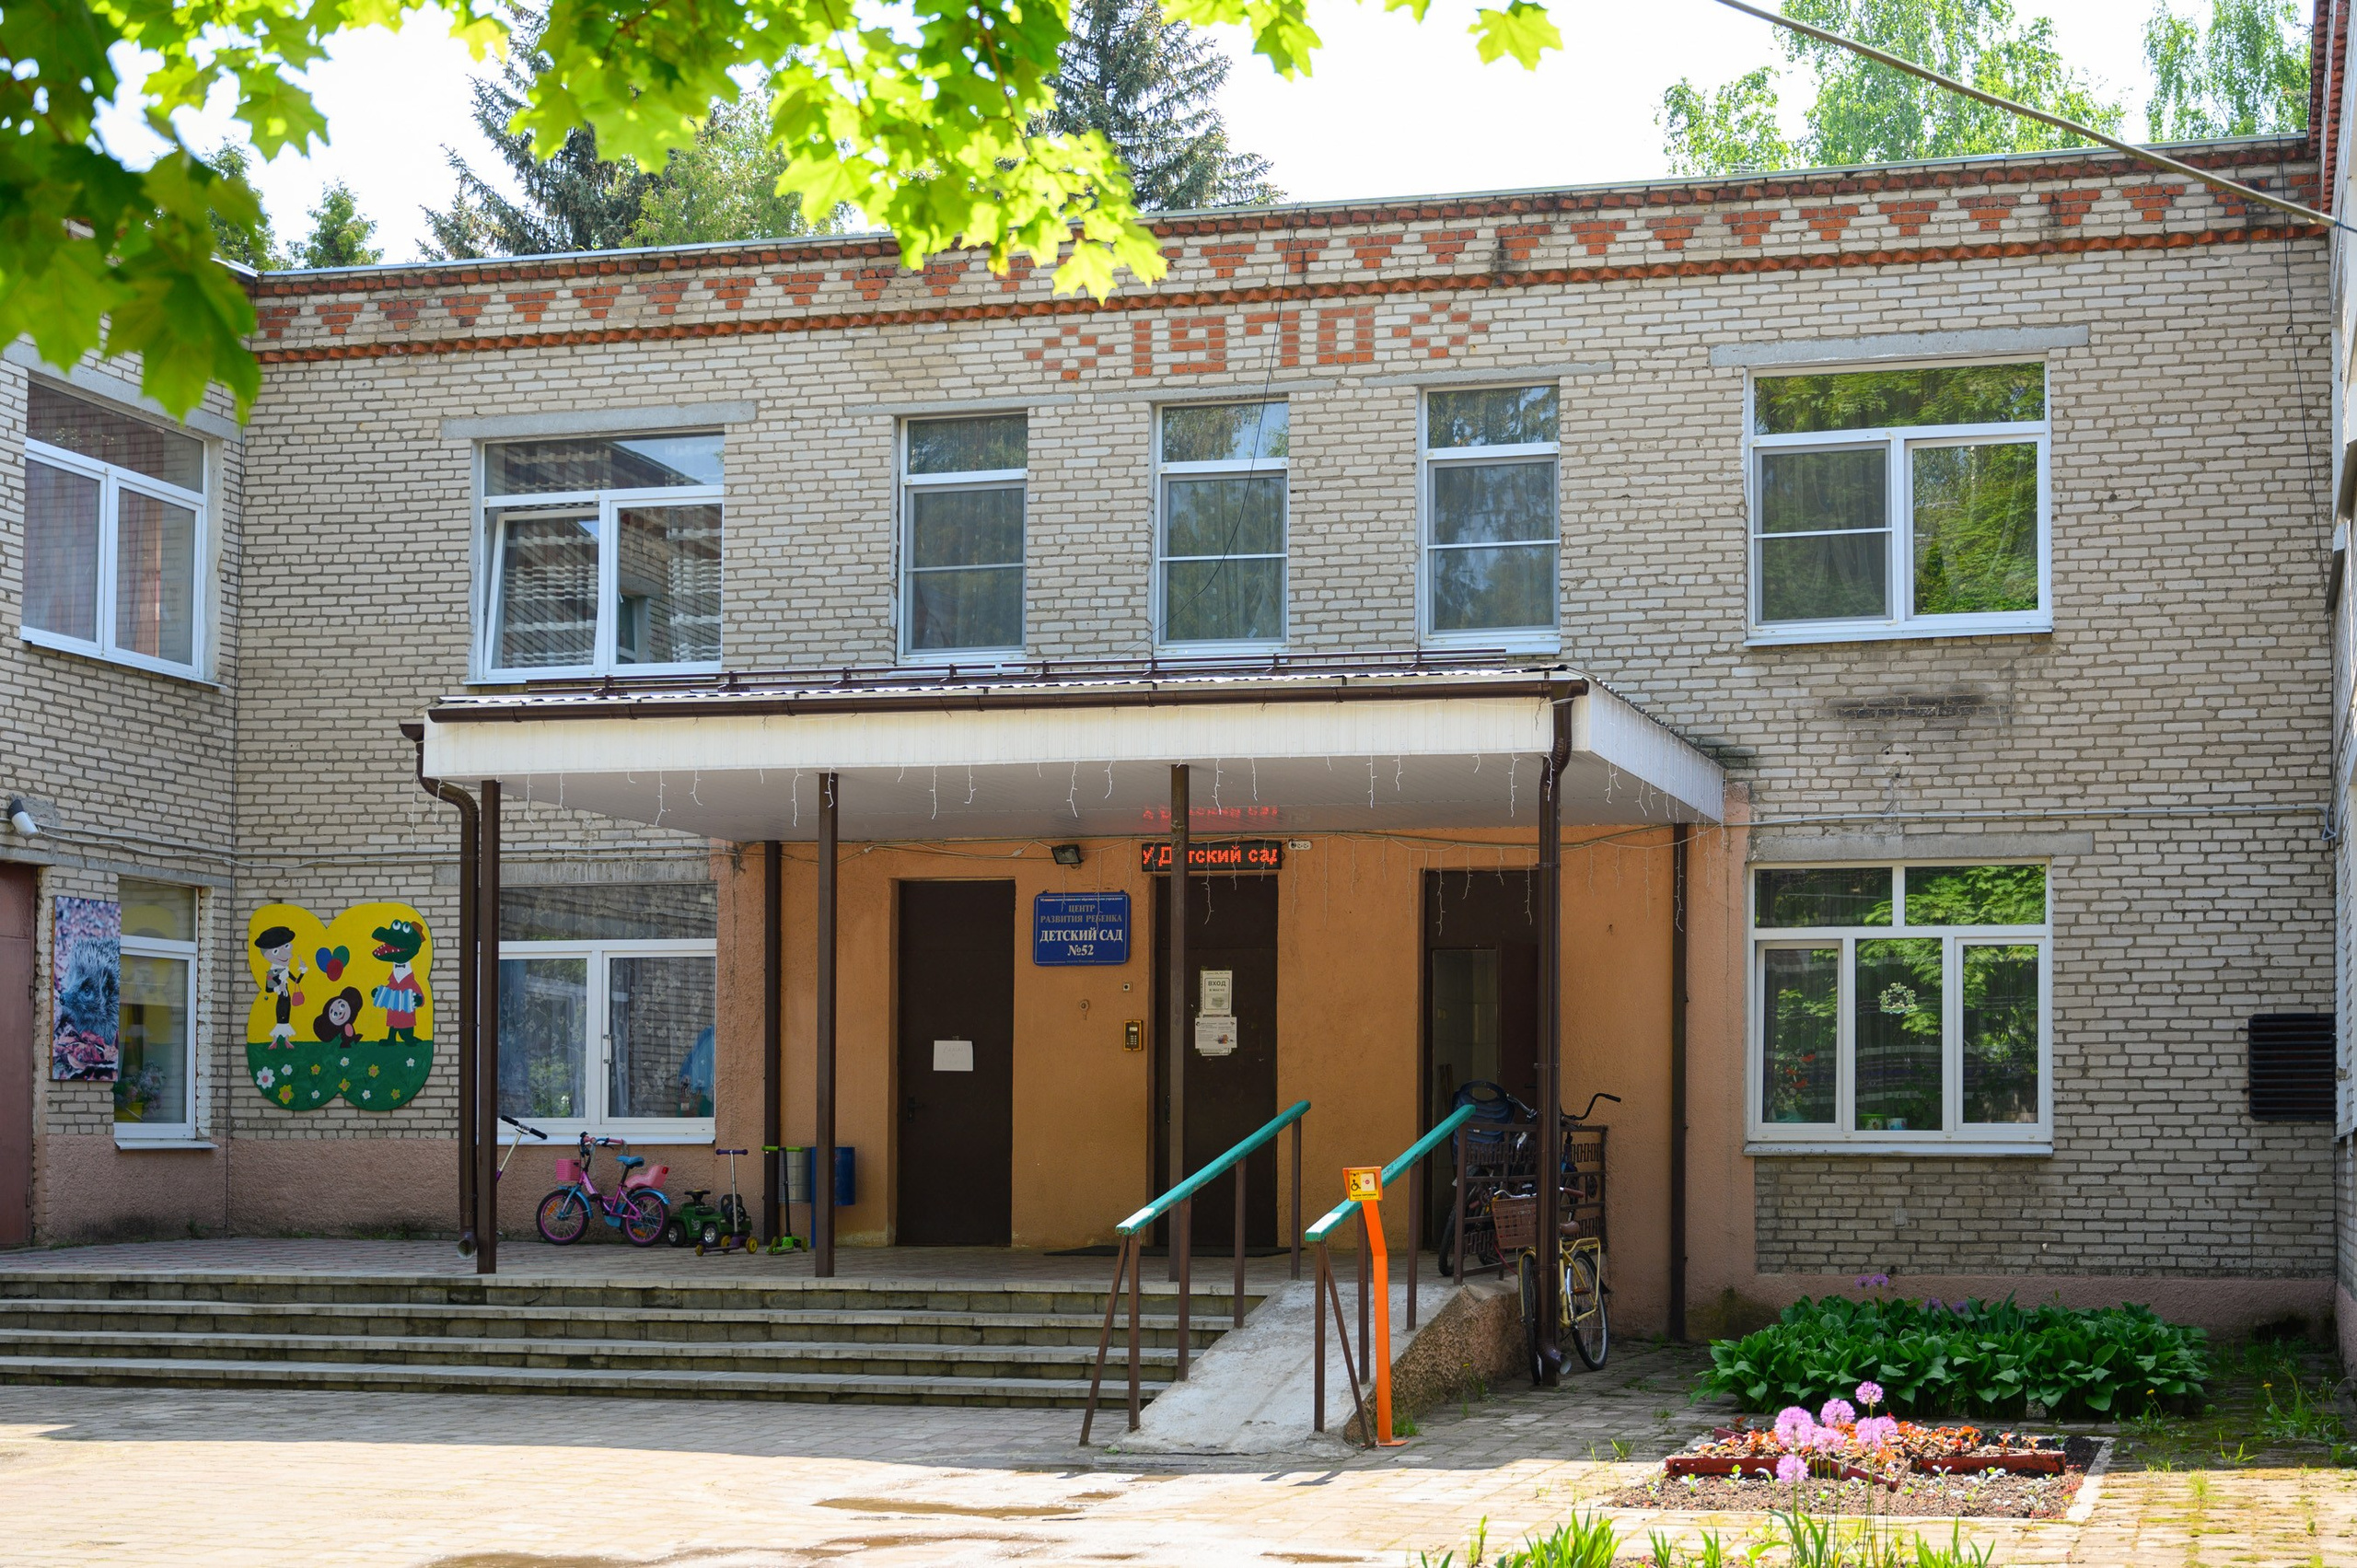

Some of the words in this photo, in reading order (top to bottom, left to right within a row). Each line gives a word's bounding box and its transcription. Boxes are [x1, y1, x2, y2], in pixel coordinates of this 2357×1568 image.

[1133, 306, 1375, 376] 1970
[1158, 845, 1241, 866] Дтский
[1068, 904, 1095, 912] ЦЕНТР
[1086, 914, 1121, 923] РЕБЕНКА
[1039, 926, 1097, 944] ДЕТСКИЙ
[1098, 929, 1123, 943] САД
[1067, 945, 1094, 956] №52
